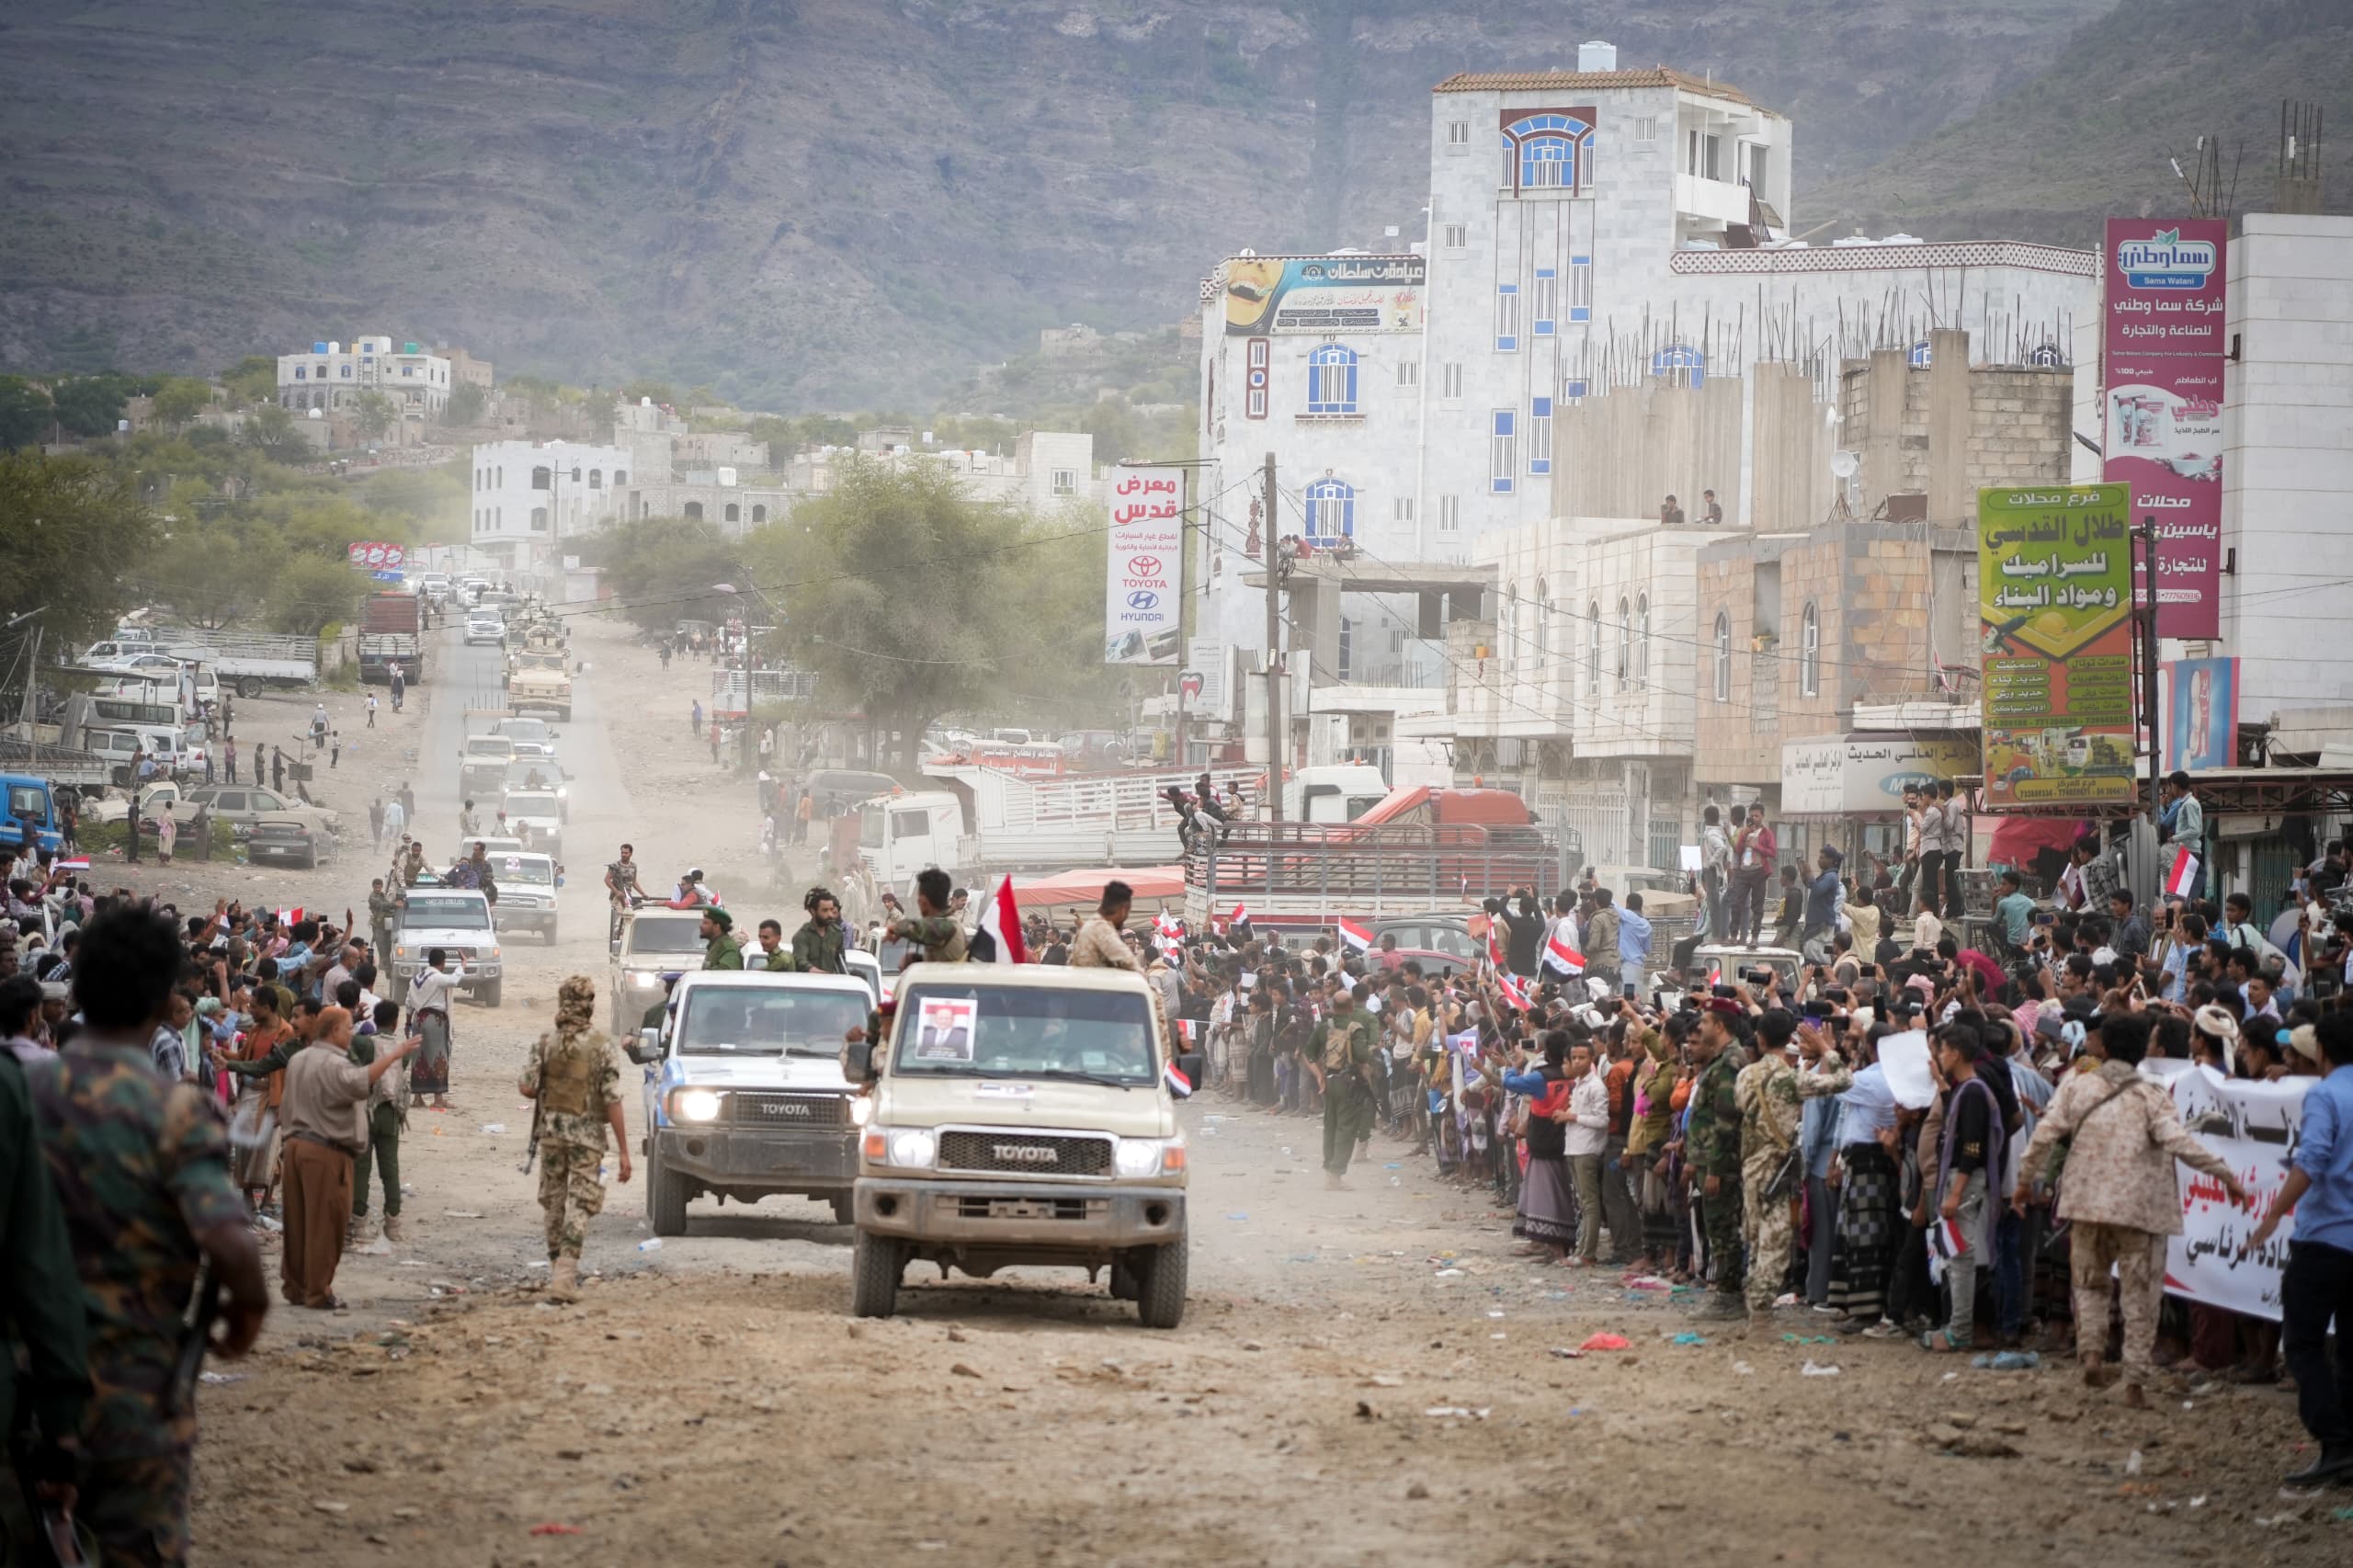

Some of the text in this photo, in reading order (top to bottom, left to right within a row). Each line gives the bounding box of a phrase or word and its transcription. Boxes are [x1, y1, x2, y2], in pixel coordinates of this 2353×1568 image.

[2143, 277, 2195, 286] Sama Watani
[2113, 296, 2223, 315] شركة سما وطني
[2121, 324, 2212, 338] للصناعة والتجارة
[1117, 474, 1176, 495] معرض
[2008, 490, 2100, 506] فرع محلات
[2137, 494, 2191, 507] محلات
[1114, 500, 1176, 524] قدس
[1985, 515, 2067, 555] القدسي
[2074, 512, 2124, 546] طلال
[2161, 522, 2218, 540] ياسين
[2001, 551, 2108, 579] للسراميك
[2158, 556, 2208, 576] للتجارة
[1122, 579, 1167, 588] TOYOTA
[1993, 583, 2118, 610] ومواد البناء
[1120, 612, 1165, 622] HYUNDAI
[1847, 744, 1892, 763] الحديث
[1894, 747, 1938, 763] العالمي
[761, 1104, 810, 1116] TOYOTA
[994, 1145, 1059, 1163] TOYOTA
